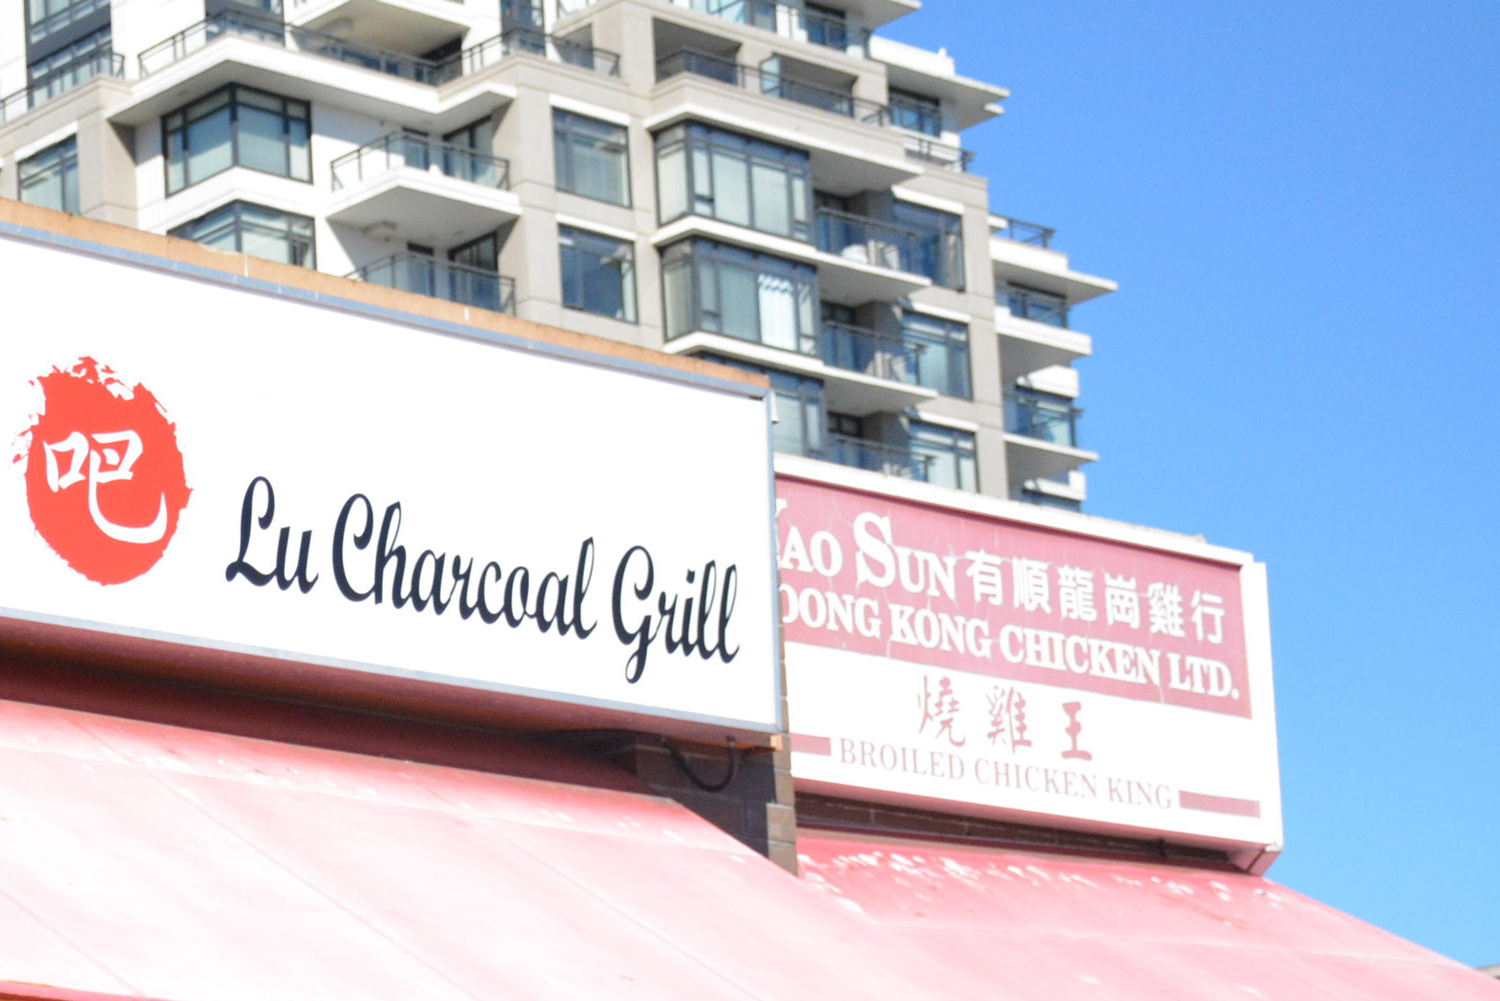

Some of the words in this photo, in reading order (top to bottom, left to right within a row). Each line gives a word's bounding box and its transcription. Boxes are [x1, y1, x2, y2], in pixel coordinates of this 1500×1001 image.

[225, 476, 318, 593] Lu
[332, 493, 597, 640] Charcoal
[611, 545, 740, 684] Grill
[775, 498, 843, 577] AO
[888, 603, 992, 660] KONG
[999, 624, 1162, 685] CHICKEN
[1167, 652, 1240, 700] LTD.
[838, 737, 965, 780] BROILED
[974, 758, 1097, 799] CHICKEN
[1107, 777, 1172, 810] KING
